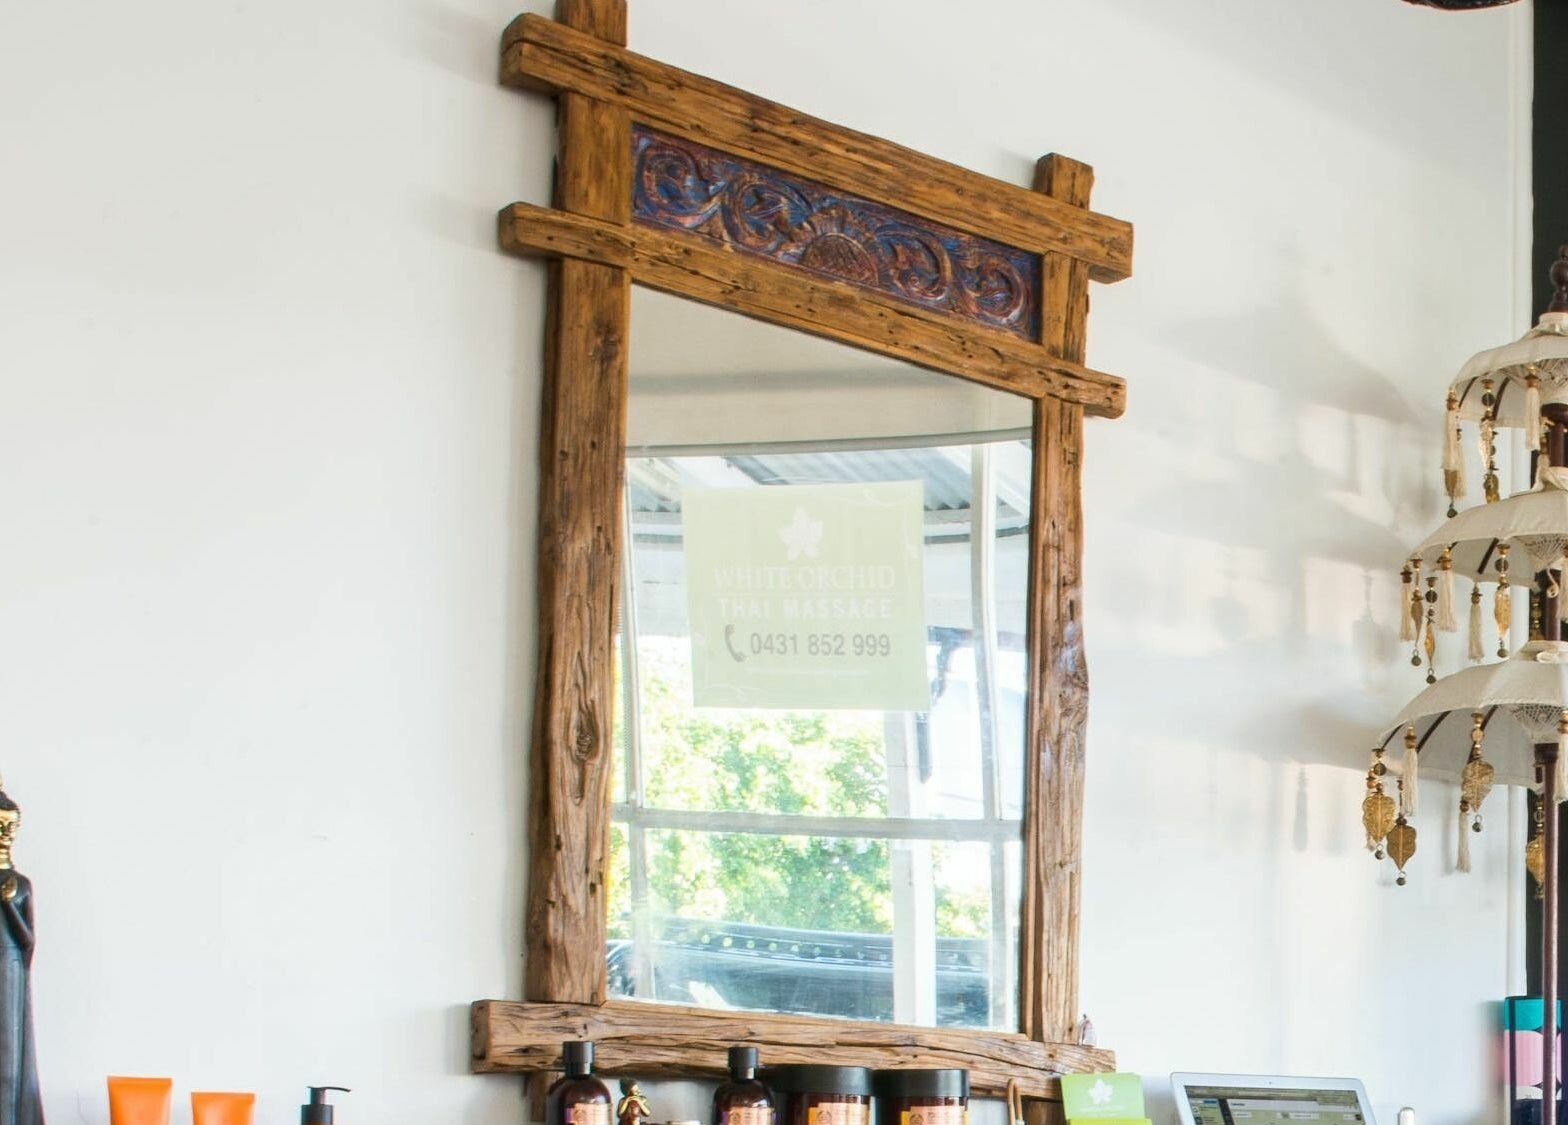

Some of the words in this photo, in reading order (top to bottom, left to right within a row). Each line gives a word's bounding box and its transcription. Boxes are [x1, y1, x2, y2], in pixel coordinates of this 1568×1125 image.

[798, 566, 896, 590] ORCHID
[717, 598, 771, 619] THAI
[783, 598, 893, 620] MASSAGE
[750, 632, 799, 655] 0431
[807, 633, 846, 656] 852
[852, 633, 891, 657] 999
